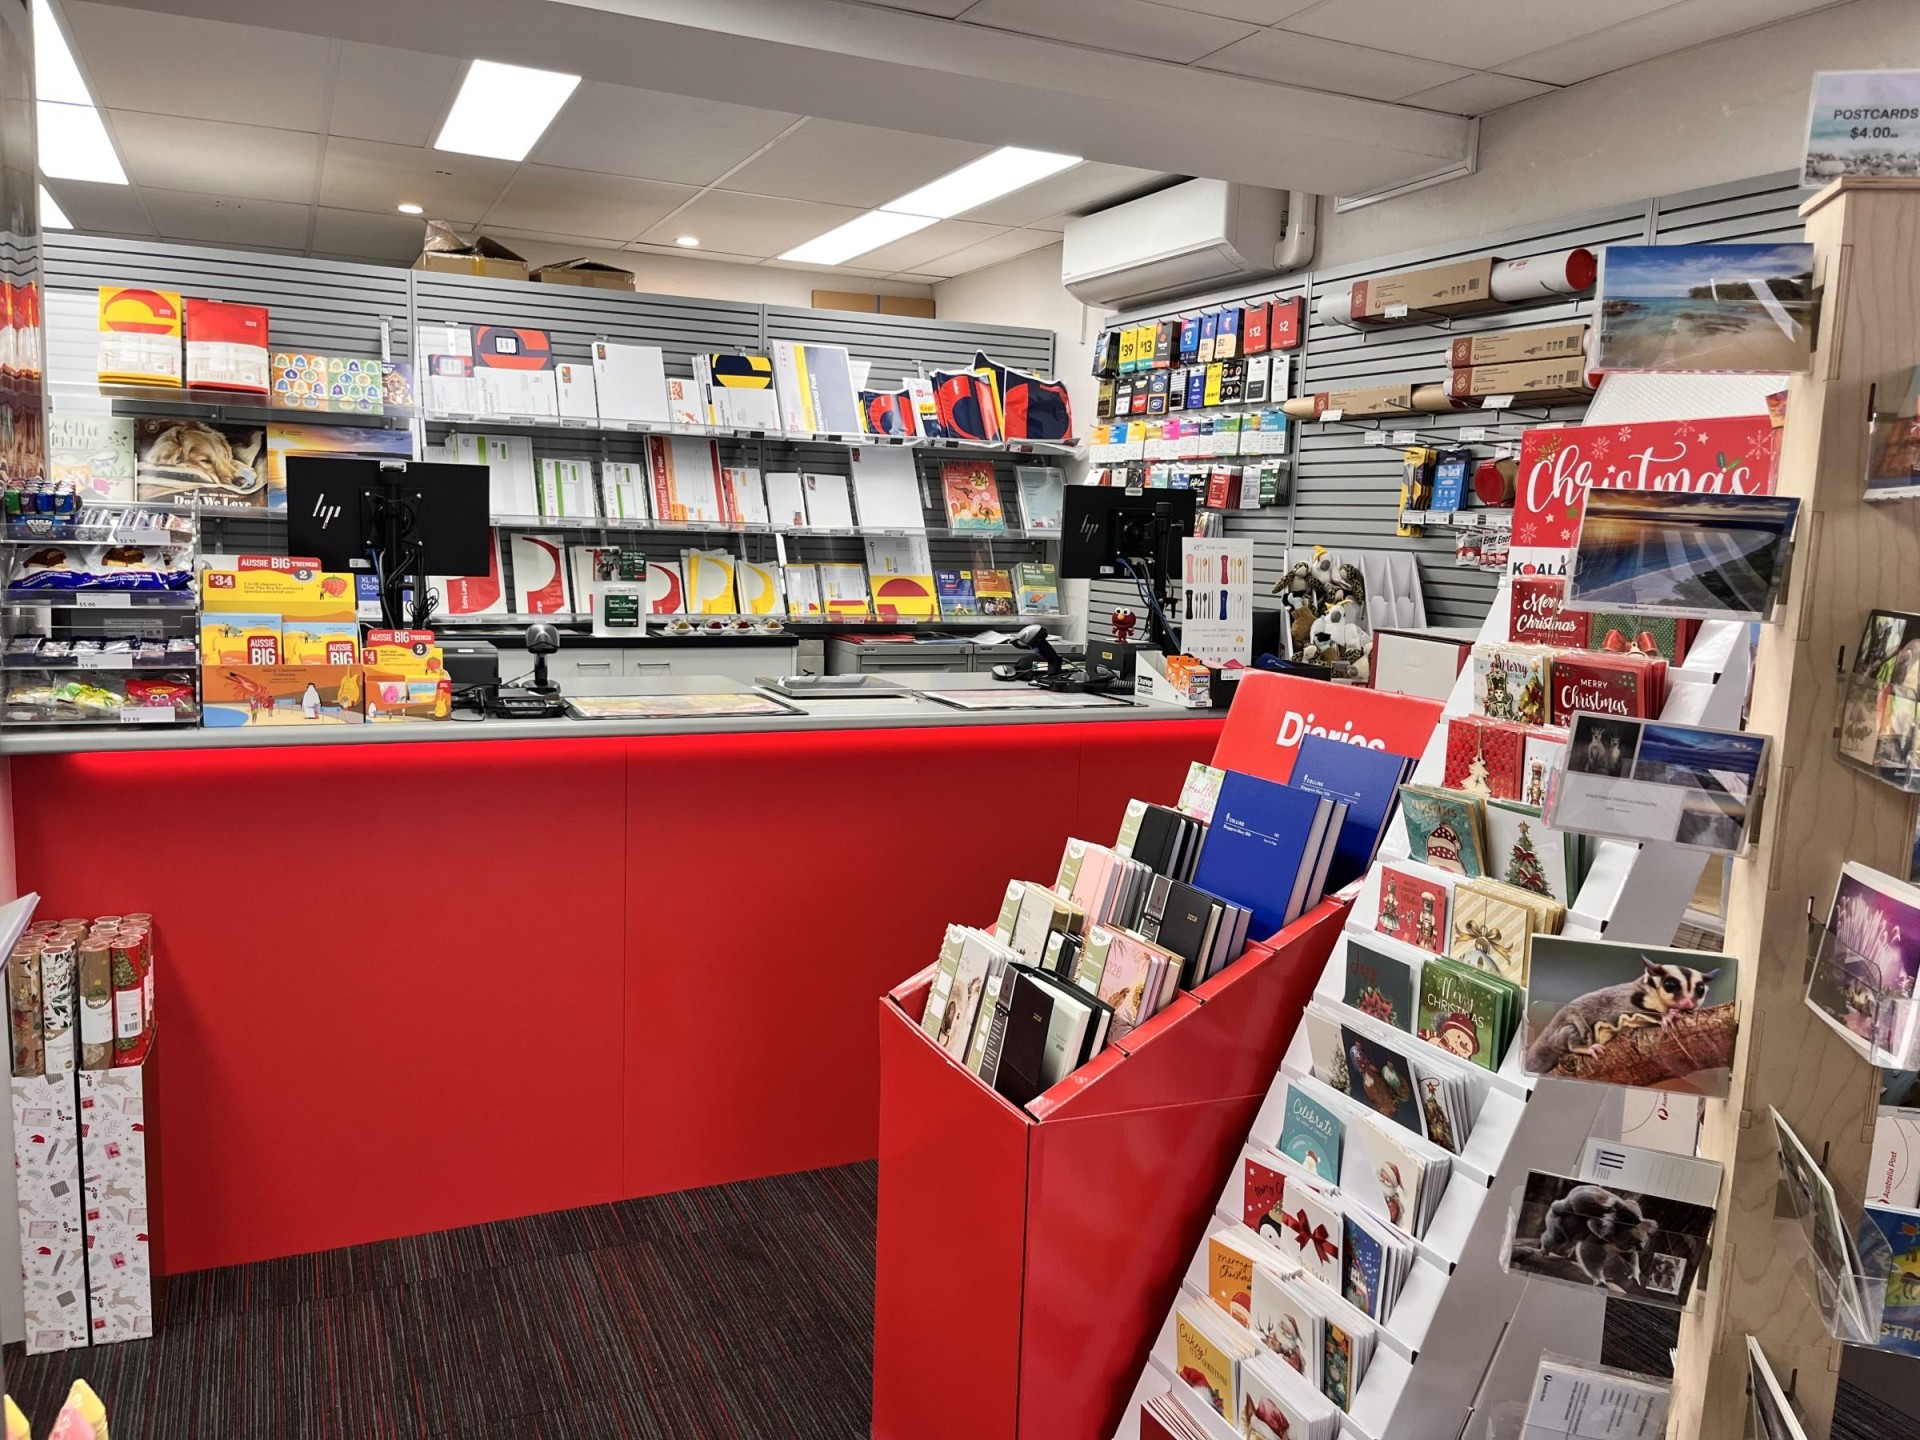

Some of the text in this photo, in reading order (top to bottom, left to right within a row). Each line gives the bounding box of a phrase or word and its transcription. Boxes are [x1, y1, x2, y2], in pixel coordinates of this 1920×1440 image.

[1834, 108, 1919, 121] POSTCARDS
[1850, 127, 1891, 140] $4.00
[1249, 326, 1261, 337] $12
[1279, 321, 1289, 332] $2
[1121, 344, 1134, 357] $39
[1140, 340, 1152, 353] $13
[1527, 441, 1761, 513] Christmas
[203, 497, 220, 506] We
[223, 498, 252, 507] Love
[312, 493, 341, 529] hp
[1080, 514, 1099, 543] hp
[1483, 535, 1497, 545] Ener
[1497, 535, 1511, 544] Ener
[241, 559, 269, 568] AUSSIE
[271, 557, 290, 569] BIG
[210, 575, 233, 586] $34
[299, 570, 308, 579] 2
[1523, 593, 1565, 615] Merry
[1516, 614, 1577, 632] Christmas
[250, 638, 275, 648] AUSSIE
[371, 633, 392, 641] AUSSIE
[394, 632, 410, 643] BIG
[329, 643, 352, 652] AUSSIE
[417, 644, 424, 653] 2
[252, 649, 276, 665] BIG
[330, 652, 354, 664] BIG
[365, 651, 375, 662] $4
[1580, 679, 1608, 689] MERRY
[1561, 685, 1629, 715] Christmas
[1106, 960, 1121, 978] 026
[1442, 976, 1474, 1012] Merry
[1427, 994, 1484, 1029] CHRISTMAS
[1293, 1098, 1332, 1136] Celebrate
[1883, 1152, 1898, 1199] Australia Post
